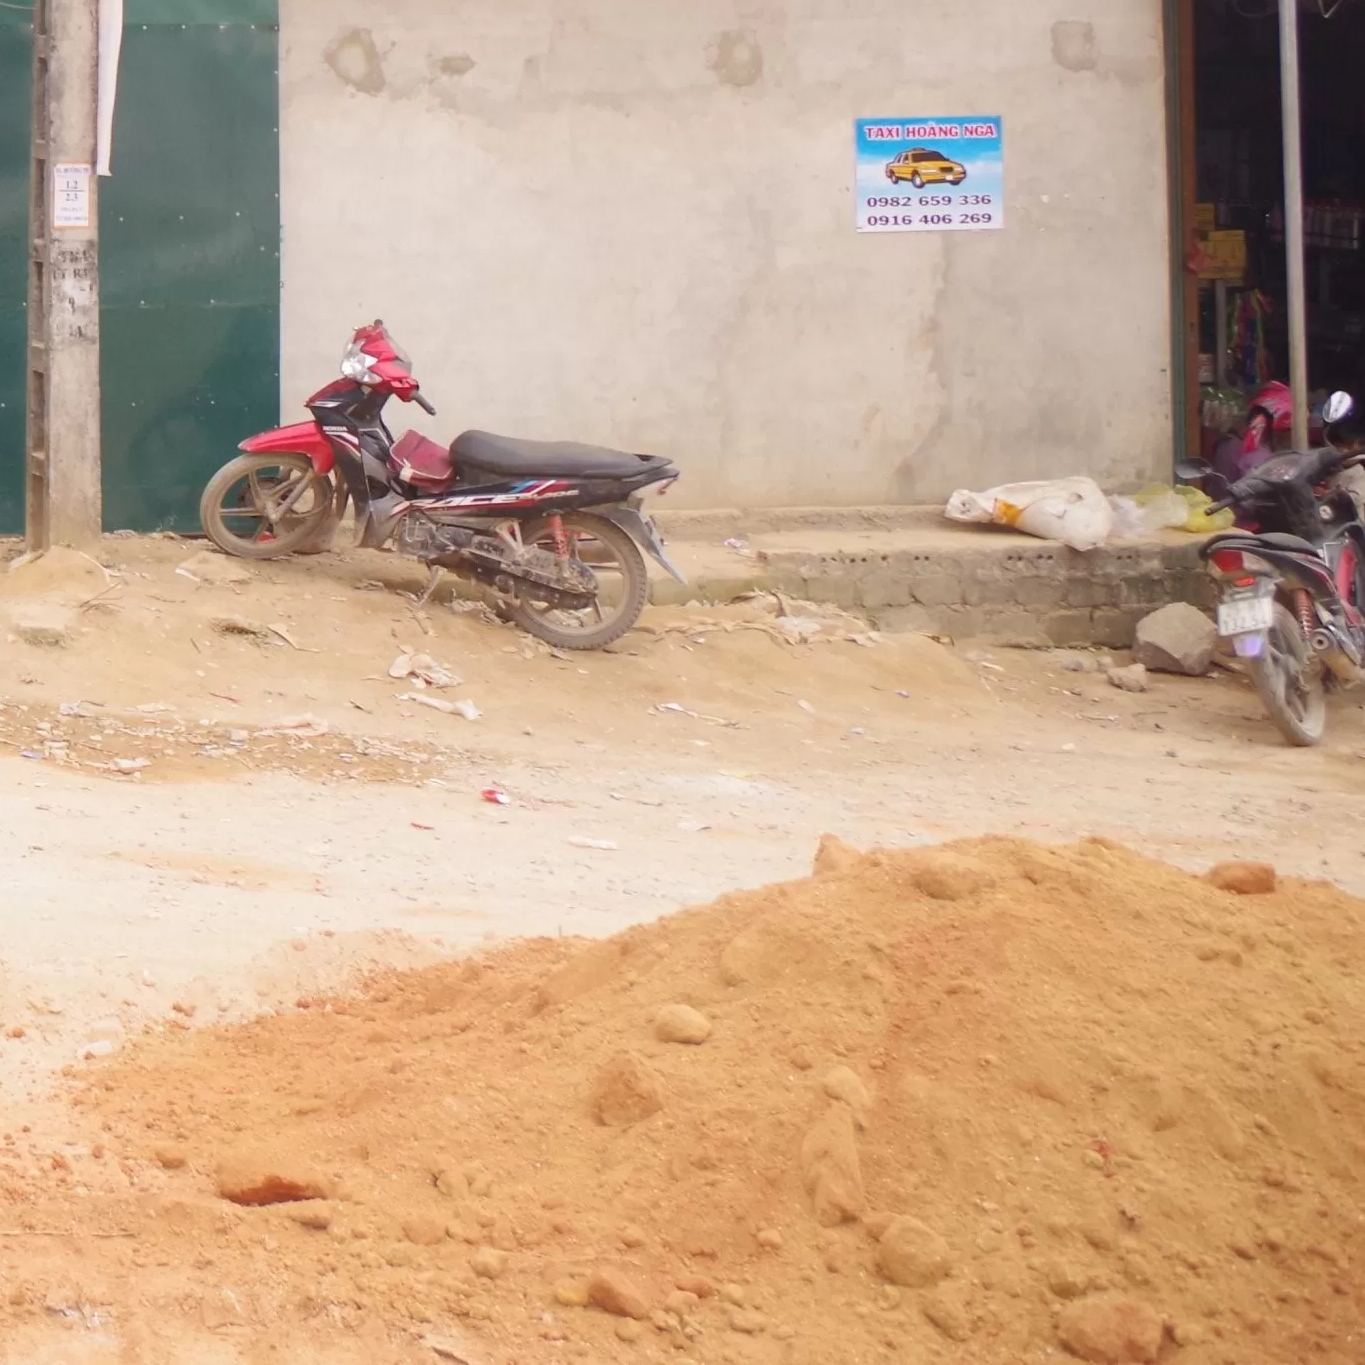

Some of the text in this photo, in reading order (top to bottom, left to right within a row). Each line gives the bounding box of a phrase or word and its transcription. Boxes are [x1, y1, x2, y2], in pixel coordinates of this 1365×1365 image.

[866, 127, 900, 139] TAXI
[964, 125, 995, 136] NGA
[867, 195, 992, 208] 0982 659 336
[867, 213, 992, 227] 0916 406 269
